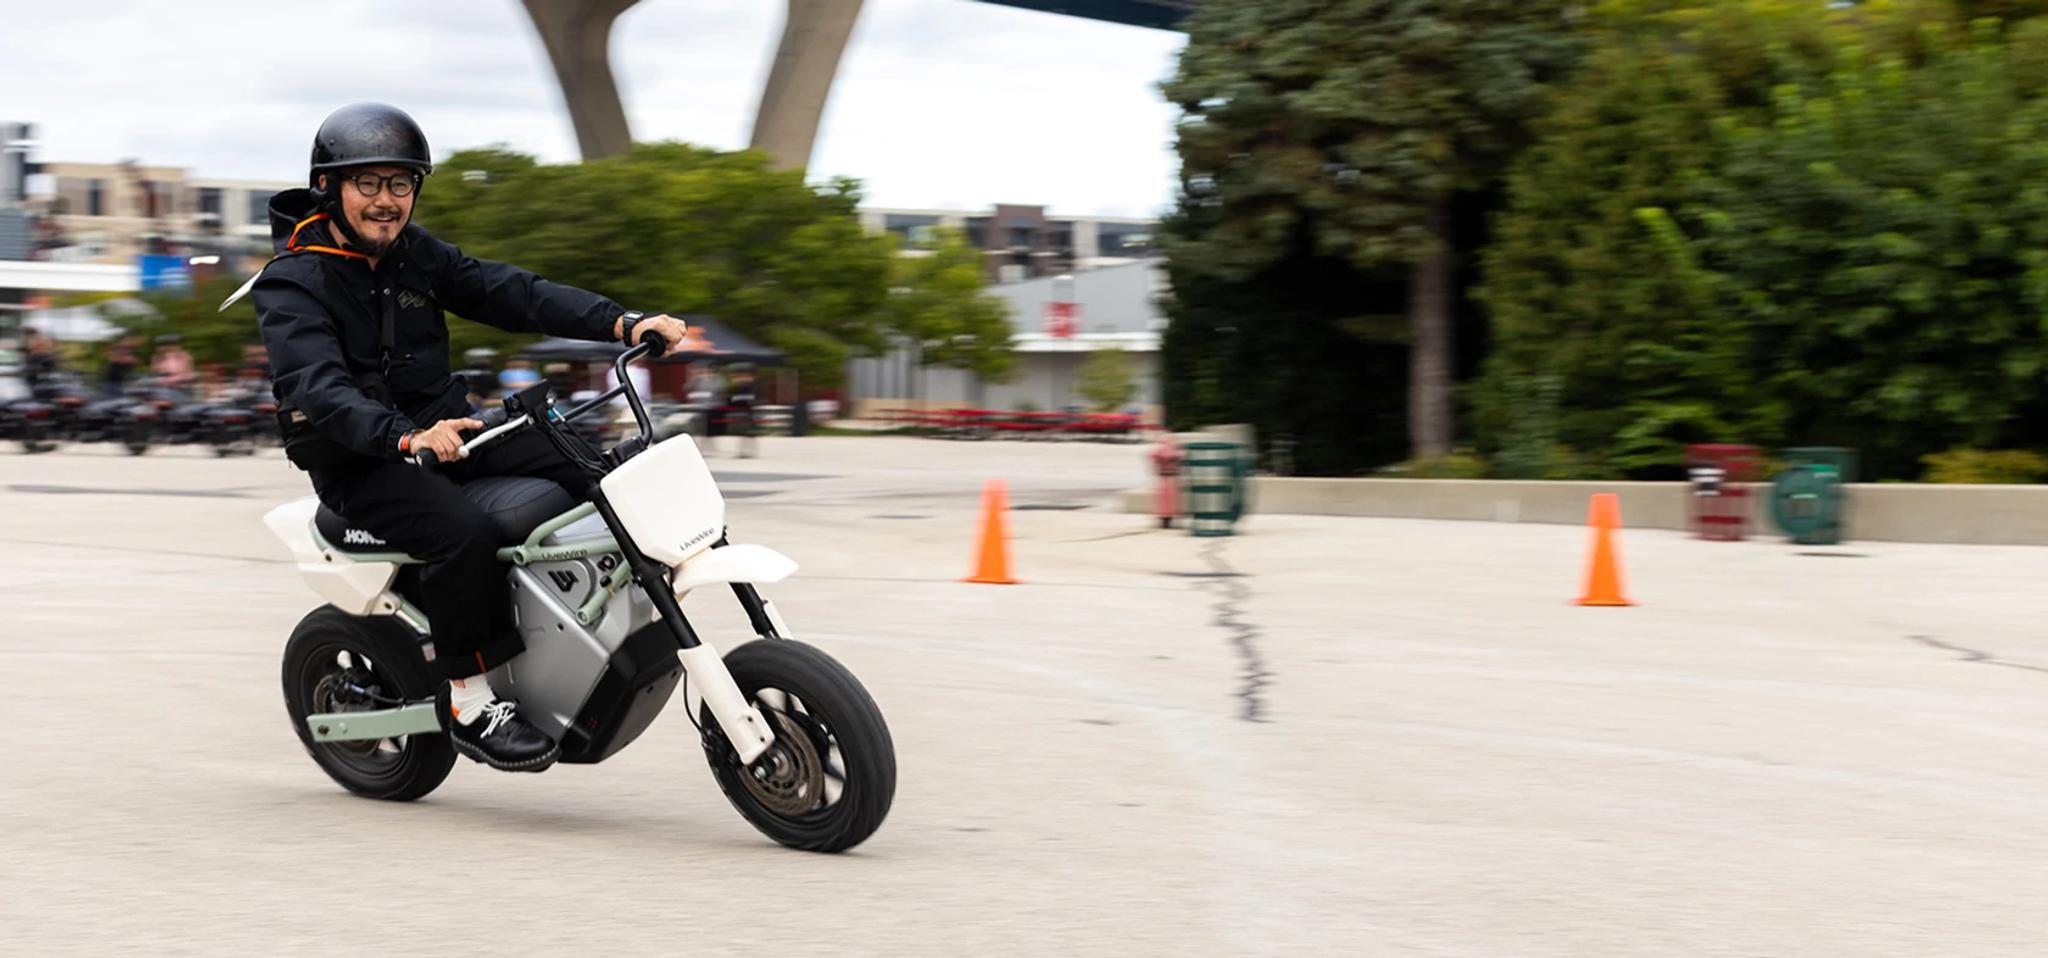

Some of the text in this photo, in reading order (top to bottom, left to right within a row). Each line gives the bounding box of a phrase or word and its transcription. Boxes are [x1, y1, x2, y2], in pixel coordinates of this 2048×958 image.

[344, 529, 386, 544] HON
[680, 528, 715, 551] LiveWire
[541, 549, 588, 560] LiveWire
